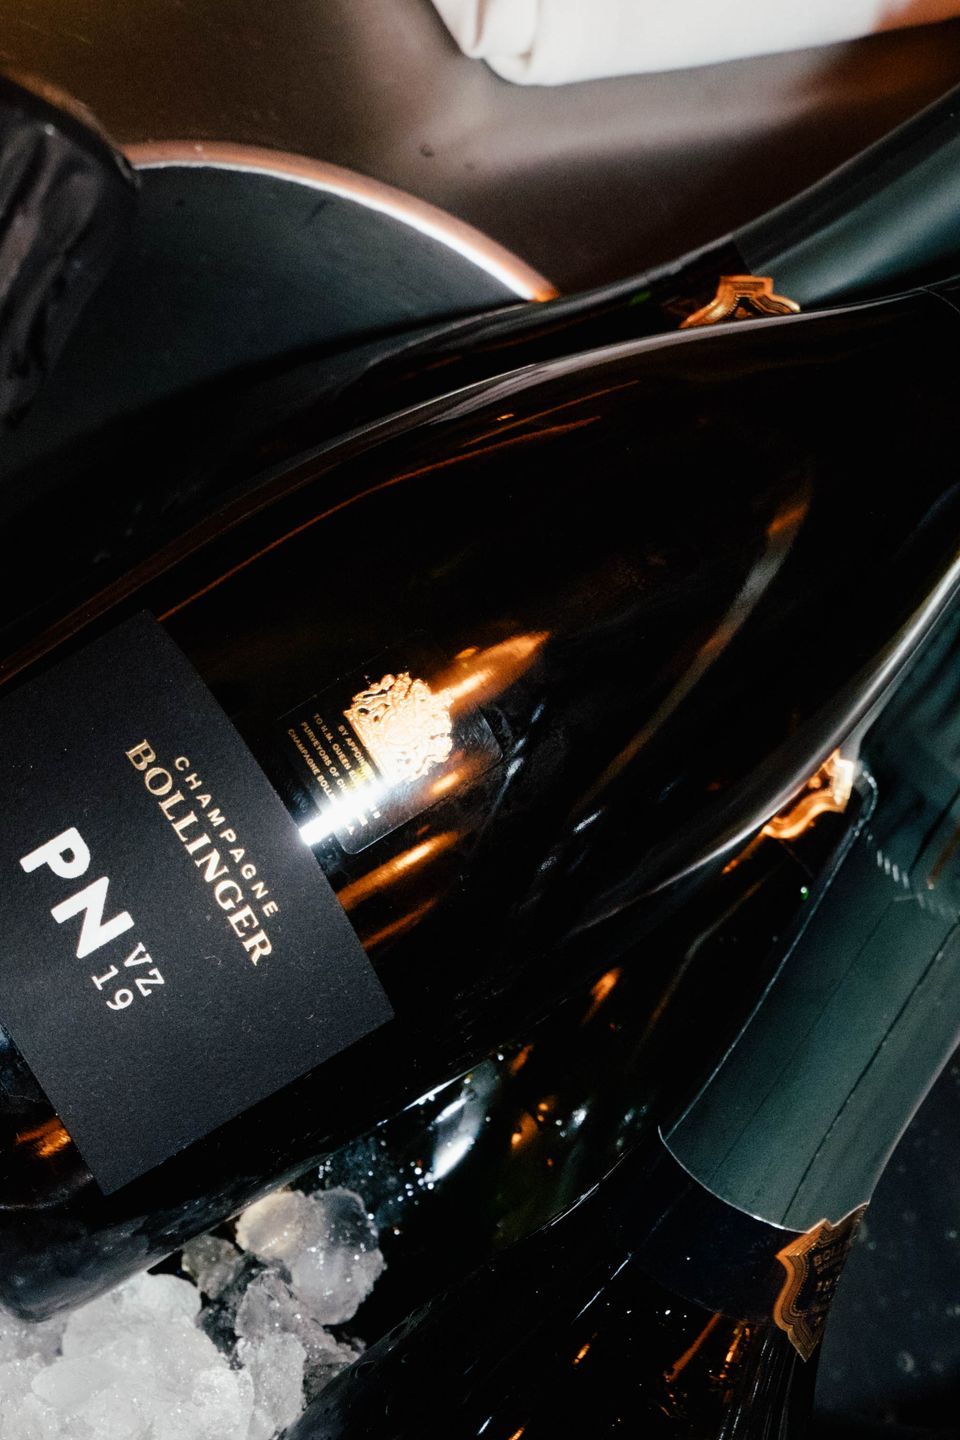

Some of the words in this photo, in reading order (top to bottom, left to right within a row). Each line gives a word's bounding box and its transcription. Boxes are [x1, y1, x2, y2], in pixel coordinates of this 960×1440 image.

[287, 727, 321, 776] CHAMPAGNE
[300, 720, 333, 767] PURVEYORS
[327, 765, 341, 780] OF
[313, 713, 324, 725] TO
[330, 742, 351, 770] QUEEN
[337, 724, 349, 737] BY
[125, 738, 277, 967] BOLLINGER
[174, 756, 280, 918] CHAMPAGNE
[19, 826, 136, 960] PN
[91, 964, 134, 1011] 19
[123, 941, 166, 998] VZ
